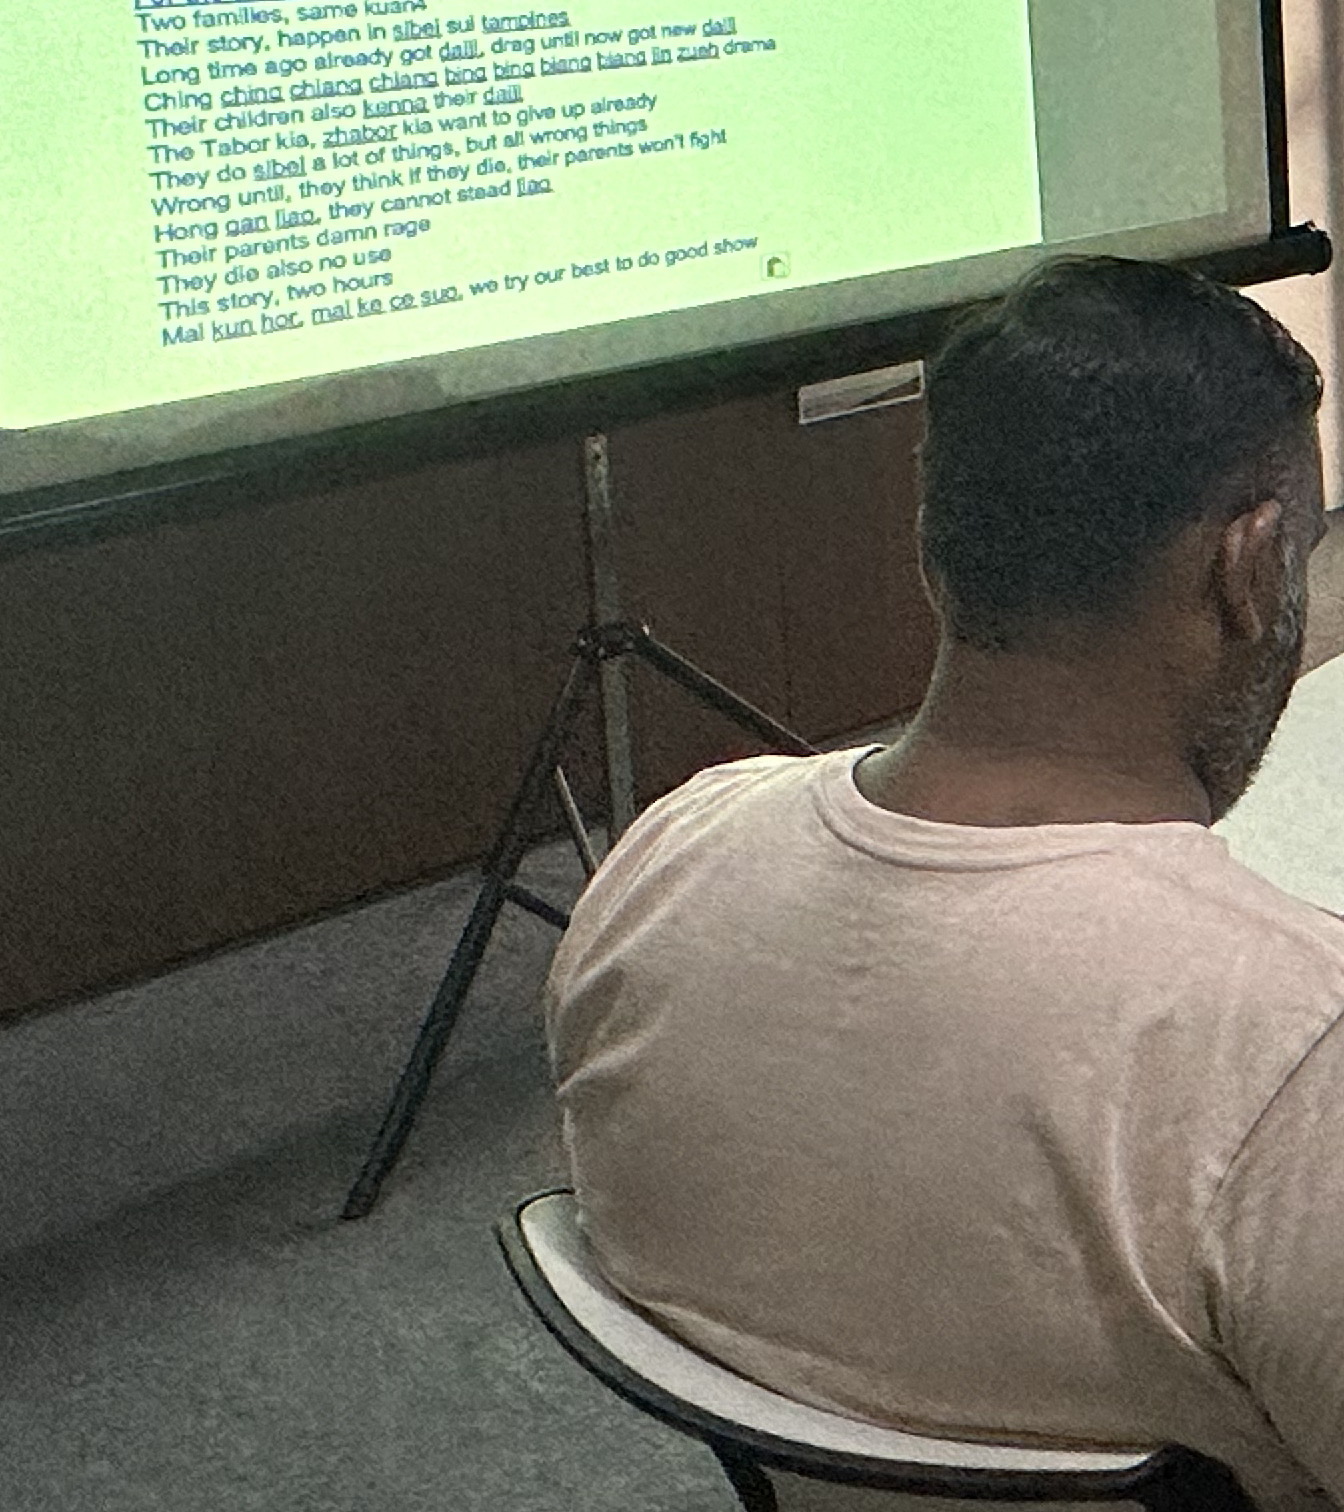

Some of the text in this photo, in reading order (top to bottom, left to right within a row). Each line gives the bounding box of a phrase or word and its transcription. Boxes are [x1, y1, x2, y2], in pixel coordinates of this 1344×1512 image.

[134, 13, 187, 30] Two
[295, 3, 358, 21] same
[136, 37, 200, 59] Their
[276, 28, 362, 49] happen
[366, 23, 387, 41] in
[147, 170, 211, 191] They
[216, 164, 247, 183] do
[311, 157, 327, 171] a
[332, 151, 360, 169] lot
[364, 147, 386, 165] of
[465, 134, 498, 153] but
[502, 128, 525, 145] all
[528, 127, 588, 144] wrong
[592, 119, 649, 137] things
[155, 219, 432, 267] Their parents damn rage
[155, 249, 392, 295] They die also no use
[159, 298, 211, 320] This
[286, 283, 327, 300] two
[332, 273, 394, 292] hours
